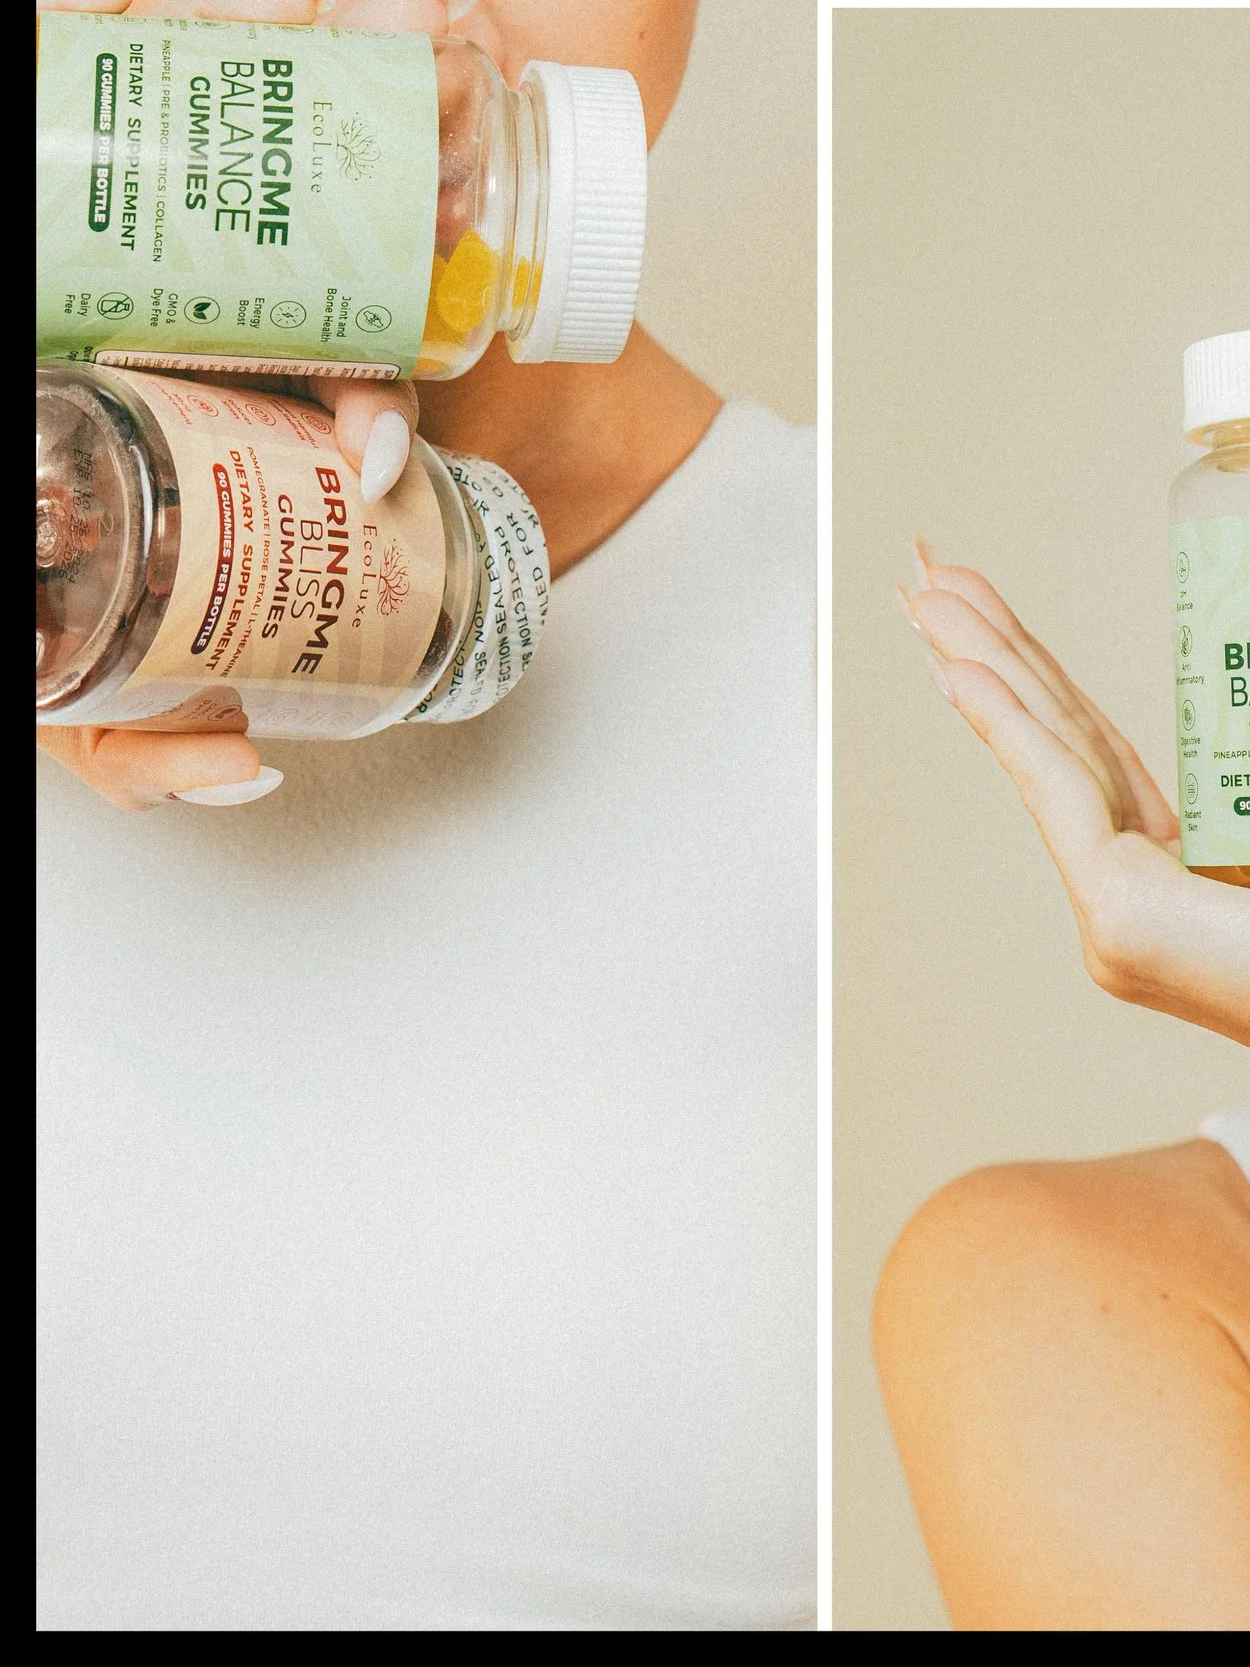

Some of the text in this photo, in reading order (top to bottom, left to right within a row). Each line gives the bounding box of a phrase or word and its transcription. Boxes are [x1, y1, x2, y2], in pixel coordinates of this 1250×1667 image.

[161, 89, 170, 109] PRE
[162, 39, 171, 82] PINEAPPLE
[94, 59, 113, 223] 90 GUMMIES PER BOTTLE
[121, 44, 143, 251] DIETARY SUPPLEMENT
[186, 76, 210, 210] GUMMIES
[215, 61, 255, 233] BALANCE
[257, 59, 293, 245] BRINGME
[311, 102, 332, 193] EcoLuxe
[153, 201, 165, 262] COLLAGEN
[64, 294, 75, 314] Free
[77, 293, 91, 317] Dairy
[150, 288, 163, 327] Dye Free
[167, 294, 178, 317] GMO
[237, 300, 249, 326] Boost
[250, 297, 265, 329] Energy
[321, 288, 337, 343] Bone Health
[337, 296, 351, 338] Joint and
[229, 449, 254, 533] DIETARY
[197, 471, 233, 647] 90 GUMMIES PER BOTTLE
[220, 446, 270, 678] POMEGRANATE ROSE PETAL L-THEANINE
[262, 494, 295, 639] GUMMIES
[291, 519, 324, 619] BLISS
[291, 467, 349, 674] BRINGME
[352, 524, 378, 628] EcoLuxe
[485, 554, 507, 634] SEALED
[495, 526, 532, 648] PROTECTION
[205, 544, 253, 671] SUPPLEMENT
